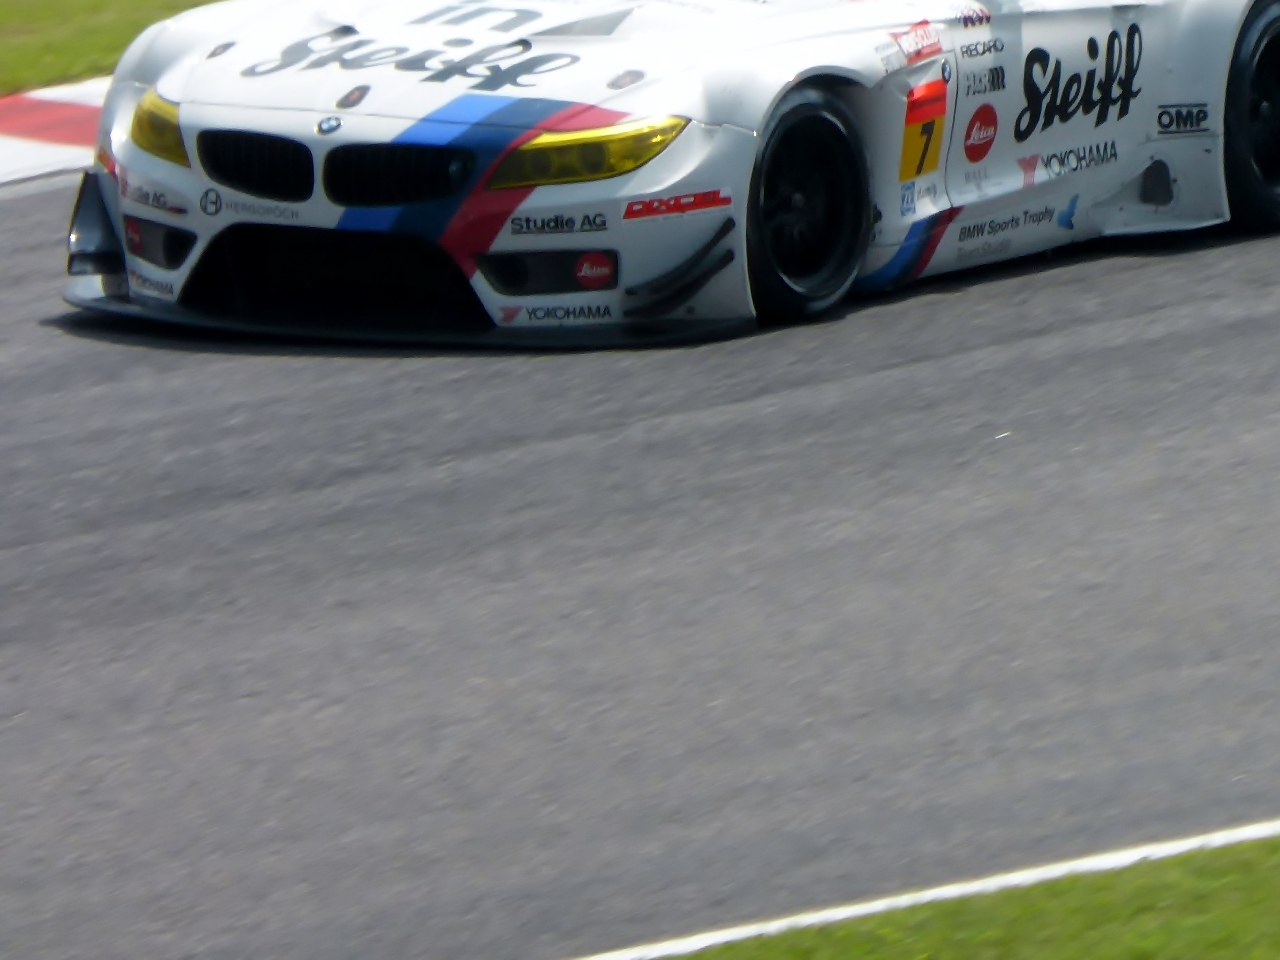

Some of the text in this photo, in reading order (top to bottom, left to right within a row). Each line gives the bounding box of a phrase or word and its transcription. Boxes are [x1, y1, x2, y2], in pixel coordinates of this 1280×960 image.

[240, 25, 581, 92] Steiff
[1014, 23, 1142, 143] Steiff
[964, 122, 995, 146] Leica
[1157, 108, 1209, 129] OMP
[915, 120, 936, 176] 7
[1041, 141, 1118, 178] YOKOHAMA
[511, 213, 608, 231] Studie AG
[958, 205, 1055, 242] BMW Sports Trophy
[526, 305, 612, 321] YOKOHAMA
